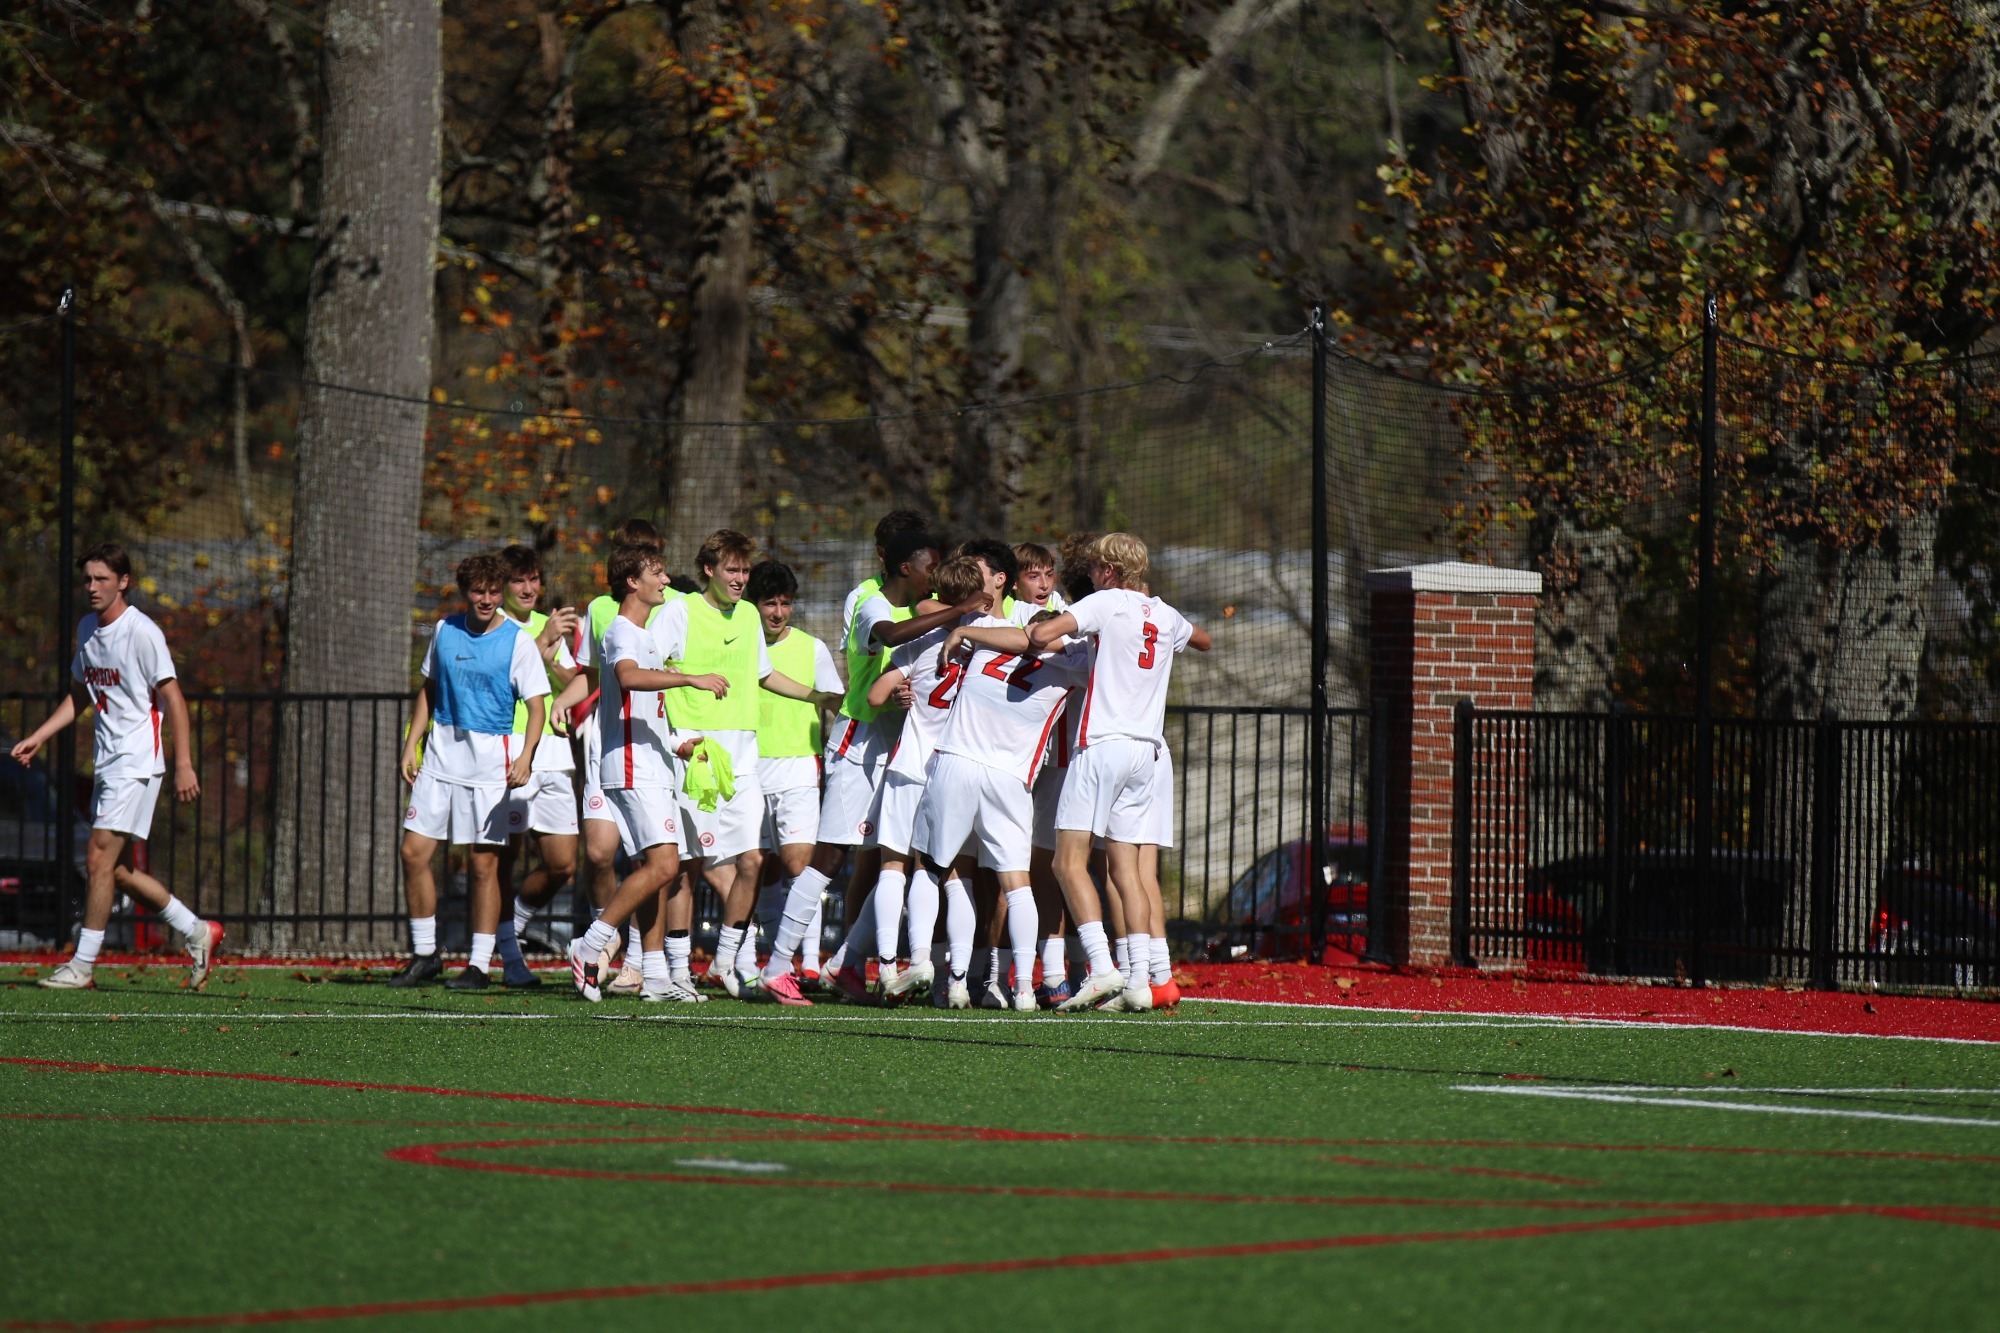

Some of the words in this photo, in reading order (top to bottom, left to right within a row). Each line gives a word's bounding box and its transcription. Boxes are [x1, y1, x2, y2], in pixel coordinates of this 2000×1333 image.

[1138, 621, 1158, 669] 3
[928, 662, 966, 709] 2
[981, 652, 1043, 692] 22
